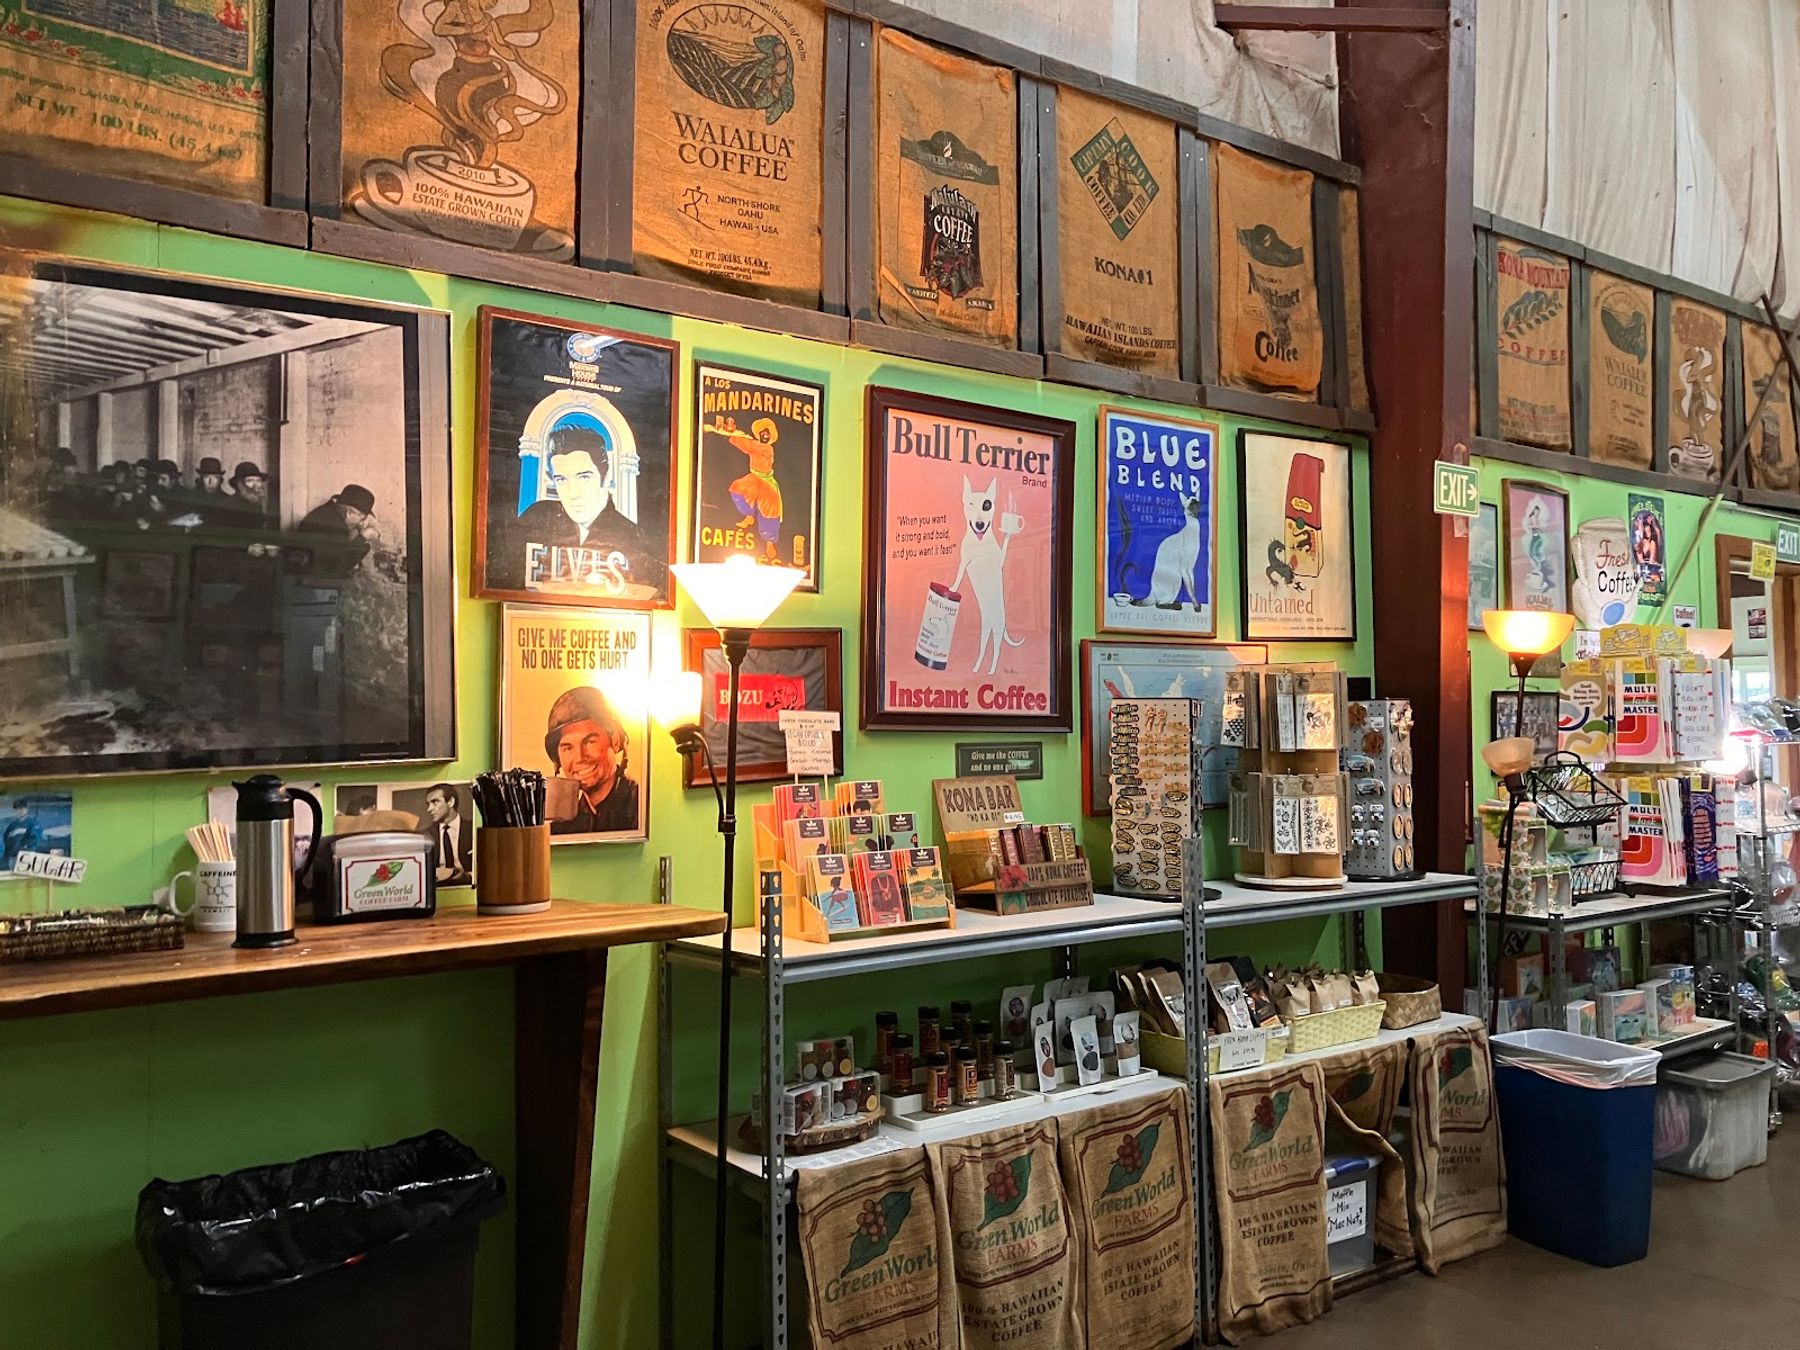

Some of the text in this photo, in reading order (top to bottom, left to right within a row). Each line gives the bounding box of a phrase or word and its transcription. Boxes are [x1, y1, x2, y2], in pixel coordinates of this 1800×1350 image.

[671, 110, 793, 159] WAIALUA
[678, 142, 788, 182] COFFEE
[1076, 131, 1113, 174] CAPTAIN
[458, 166, 486, 181] 2010
[1119, 139, 1154, 195] COOK
[413, 192, 522, 228] ESTATE GROWN COFFEE
[415, 182, 524, 218] 100% HAWAIIAN
[717, 194, 781, 213] NORTH SHORE
[1085, 174, 1116, 220] COFFEE
[719, 218, 779, 235] HAWAII USA
[737, 208, 764, 220] OAHU
[933, 214, 974, 243] COFFEE
[1066, 314, 1177, 350] HAWAIIAN ISLANDS COFFEE
[1254, 331, 1299, 363] Coffee
[1497, 338, 1568, 362] COFFEE
[705, 376, 732, 390] A LOS
[1607, 374, 1648, 397] COFFEE
[703, 390, 815, 425] MANDARINES
[892, 416, 1050, 475] Bull Terrier
[1115, 426, 1207, 471] BLUE
[1022, 475, 1048, 489] Brand
[1117, 464, 1201, 494] BLEND
[1440, 471, 1469, 508] EXIT
[919, 517, 931, 528] you
[931, 515, 947, 524] want
[701, 526, 756, 550] CAFÉS
[901, 533, 922, 544] strong
[922, 529, 935, 541] and
[1778, 528, 1799, 556] EXIT
[893, 546, 934, 560] and you want
[524, 541, 628, 597] ELVIS
[1249, 590, 1314, 615] Untamed
[517, 627, 637, 651] GIVE ME COFFEE AND
[521, 649, 629, 670] NO ONE GETS HURT
[719, 689, 763, 705] BZU
[888, 680, 1048, 712] Instant Coffee
[1624, 685, 1657, 694] MULTI
[1623, 705, 1659, 715] MASTER
[970, 750, 1030, 761] Give me the COFFEE
[970, 762, 983, 772] and
[983, 763, 992, 772] no
[992, 763, 1004, 772] one
[943, 784, 1016, 813] KONA BAR
[1629, 805, 1663, 815] MULTI
[1628, 826, 1664, 836] MASTER
[1063, 832, 1076, 858] KONA
[17, 853, 86, 881] SUGAR
[1045, 864, 1062, 880] KONA
[354, 884, 414, 900] Green World
[1230, 1134, 1313, 1171] Green World
[1253, 1160, 1289, 1181] FARMS
[1133, 1168, 1176, 1209] World
[1092, 1192, 1134, 1220] Green
[1111, 1203, 1160, 1229] FARMS
[1262, 1201, 1318, 1223] HAWAIIAN
[1336, 1202, 1350, 1213] Mix
[957, 1204, 1061, 1252] Green World
[1241, 1215, 1319, 1240] ESTATE GROWN
[1257, 1231, 1295, 1249] COFFEE
[987, 1235, 1038, 1266] FARMS
[1126, 1238, 1180, 1273] HAWAIIAN
[824, 1260, 885, 1304] Green
[1103, 1253, 1181, 1296] ESTATE GROWN
[1001, 1277, 1065, 1314] HAWAIIAN
[1119, 1277, 1164, 1302] COFFEE
[963, 1295, 1065, 1329] ESTATE GROWN
[991, 1319, 1044, 1343] COFFEE
